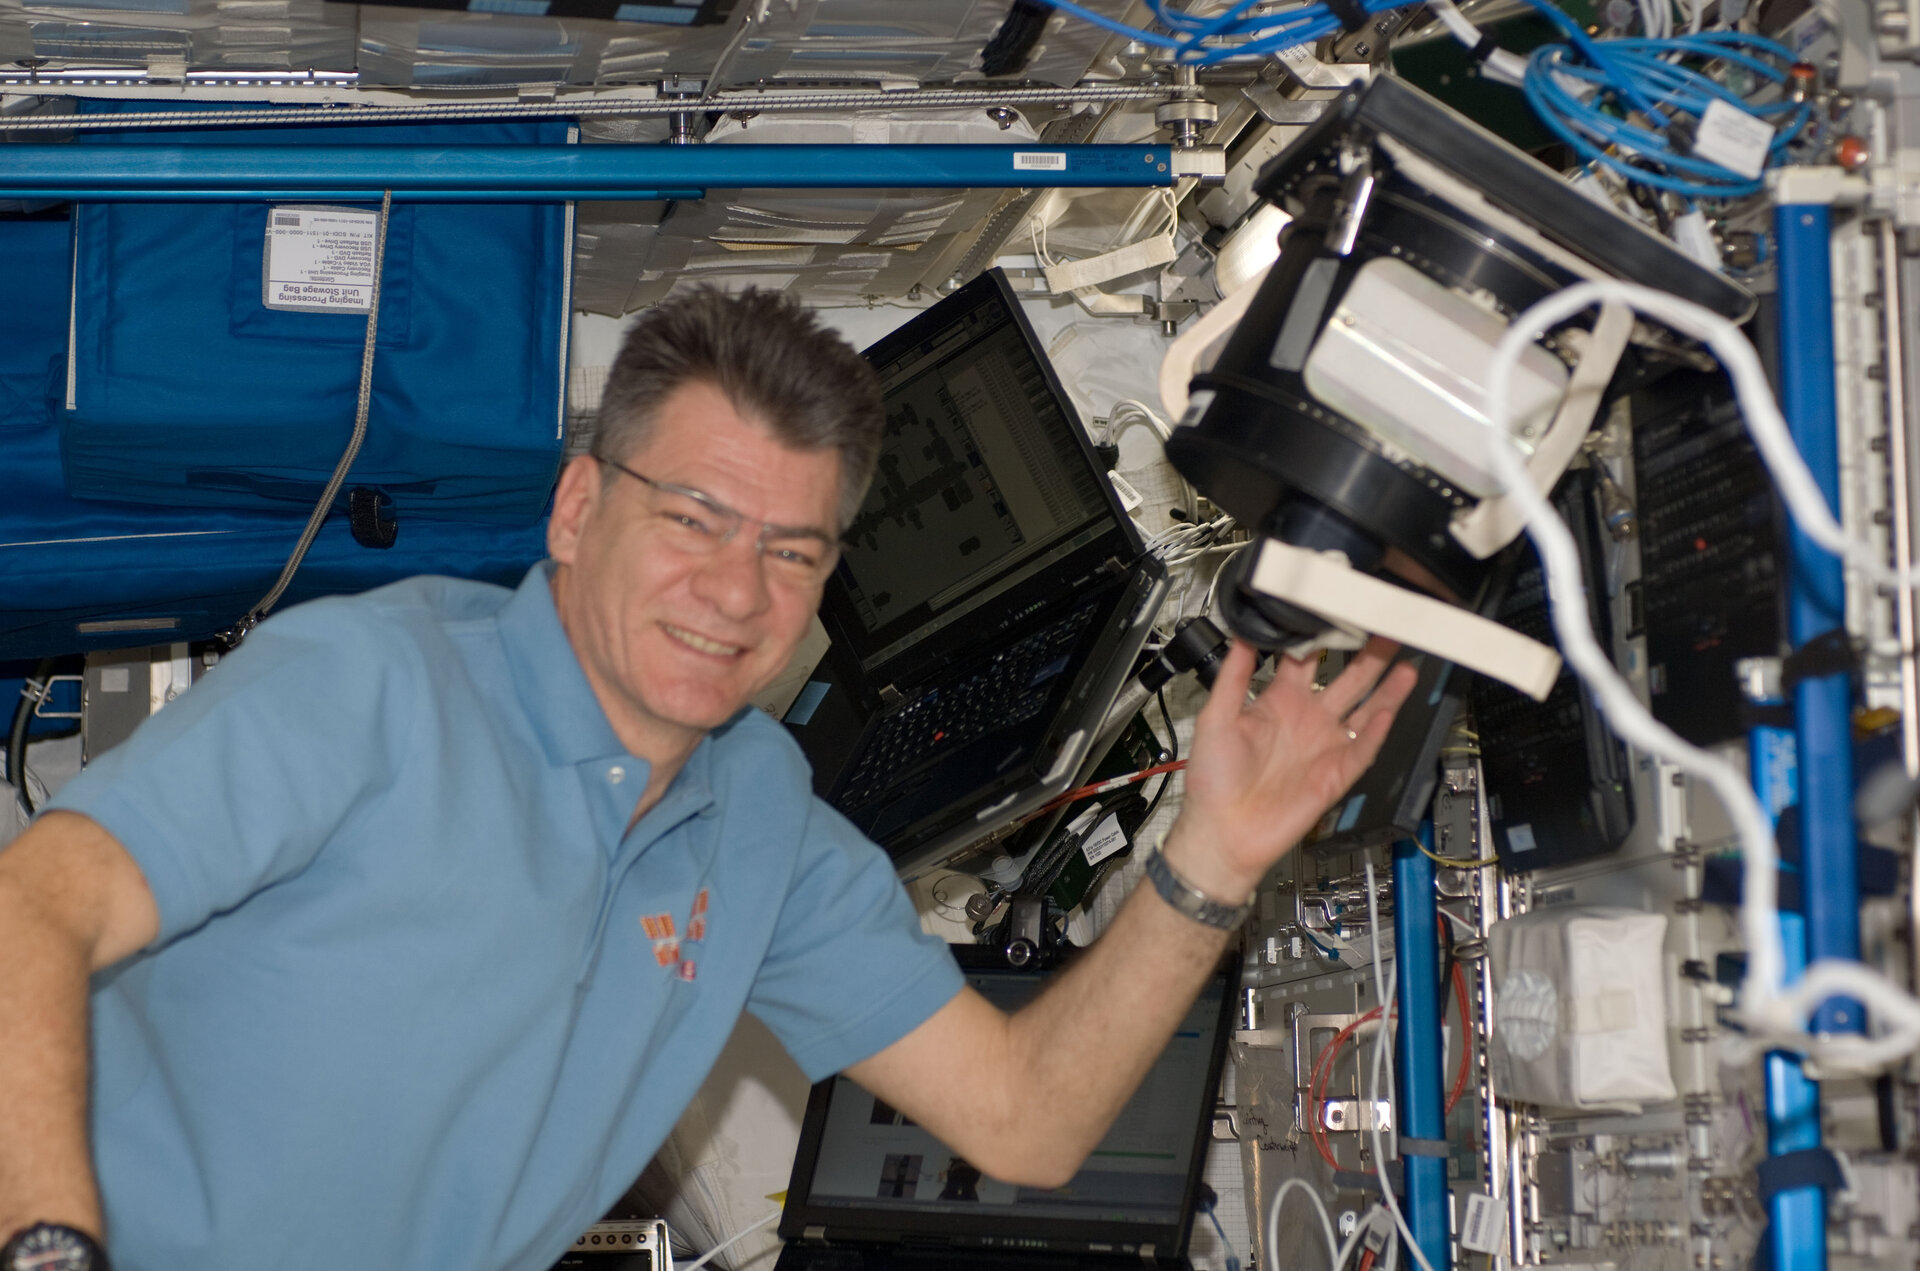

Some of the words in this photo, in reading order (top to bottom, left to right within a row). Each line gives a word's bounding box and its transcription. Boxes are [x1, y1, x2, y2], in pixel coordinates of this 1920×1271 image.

[284, 285, 300, 294] Bag
[303, 287, 339, 295] Stowage
[279, 293, 326, 304] Processing
[330, 296, 363, 305] Imaging
